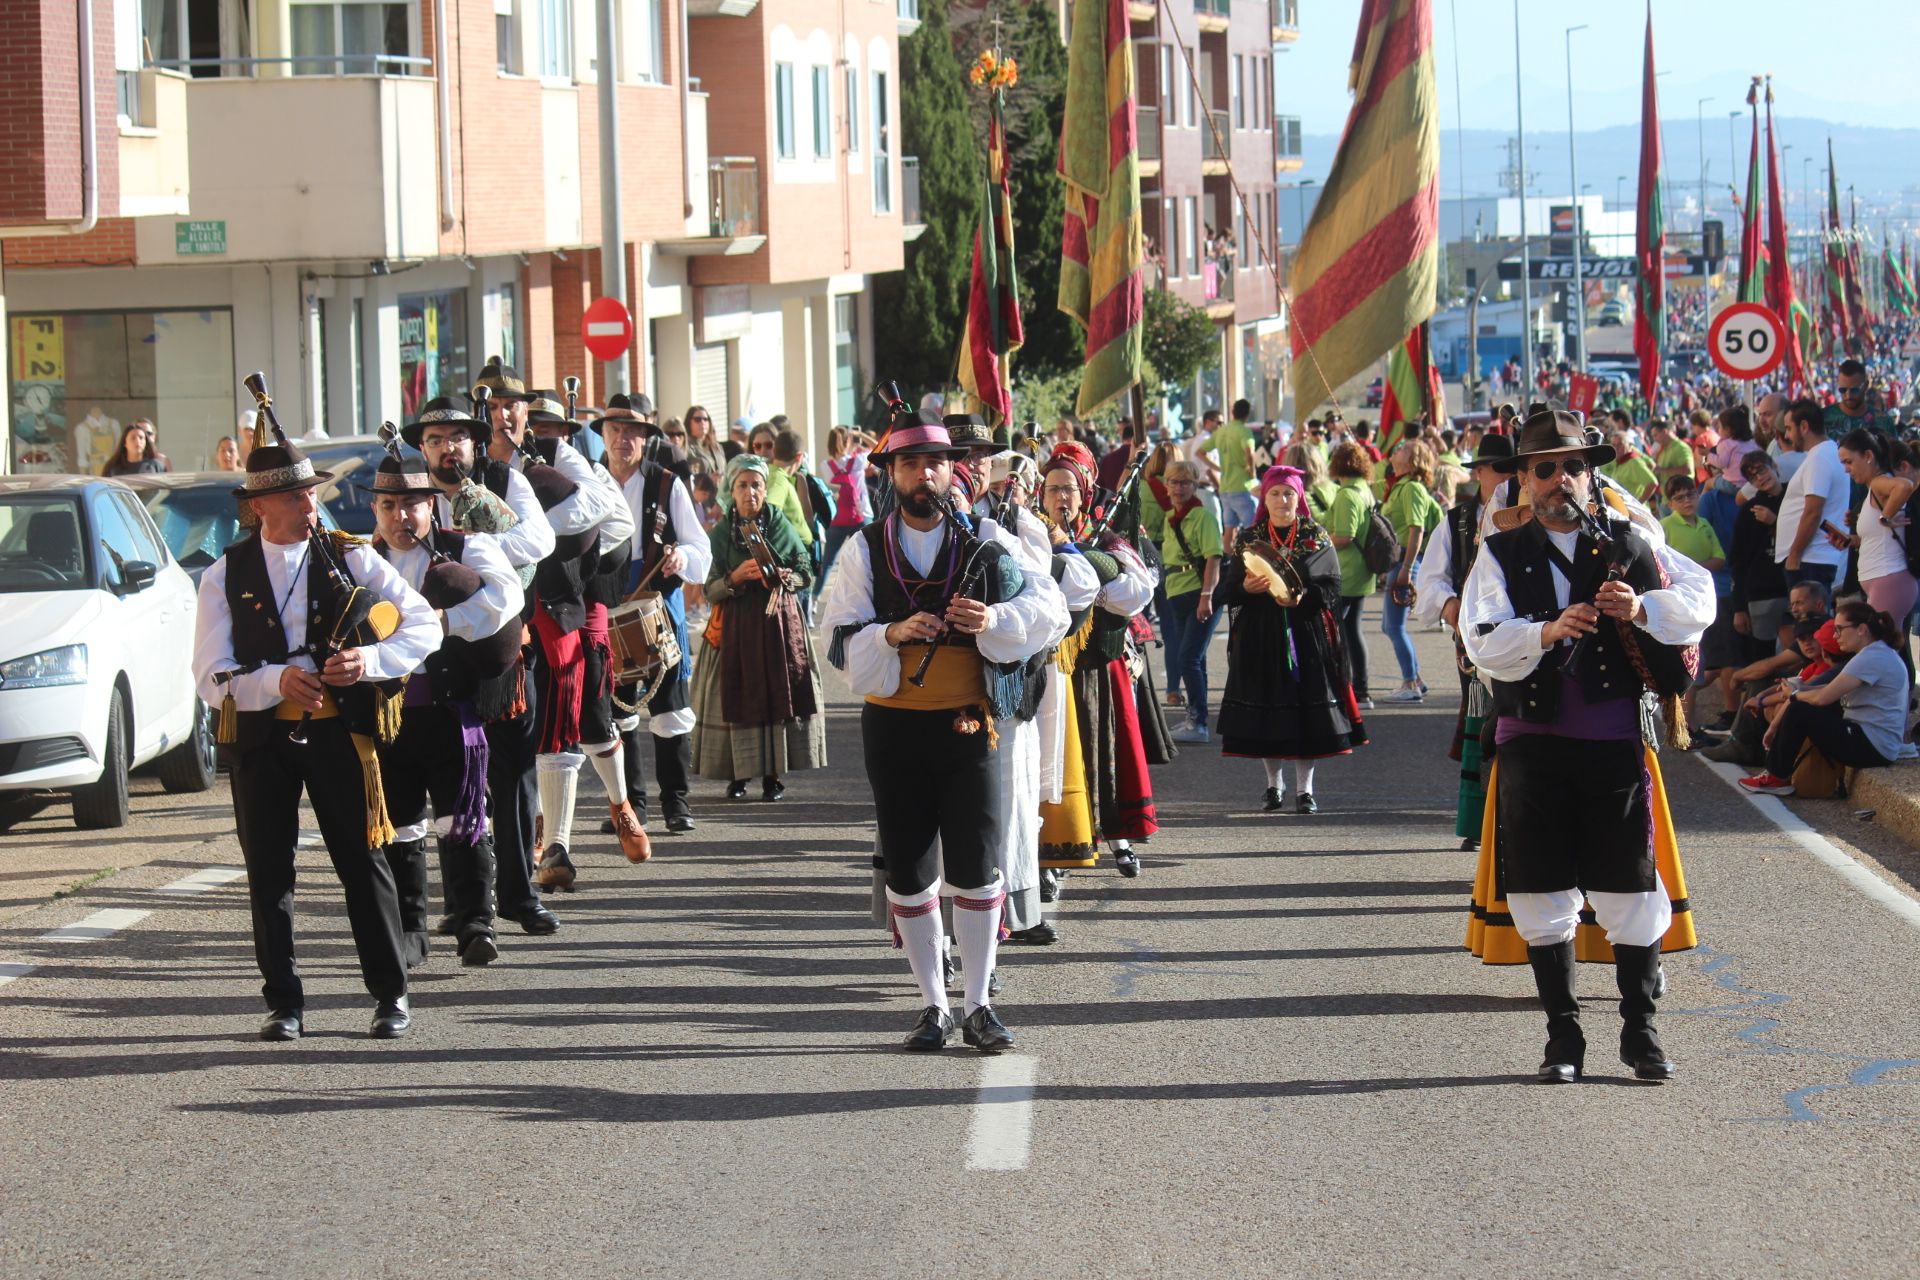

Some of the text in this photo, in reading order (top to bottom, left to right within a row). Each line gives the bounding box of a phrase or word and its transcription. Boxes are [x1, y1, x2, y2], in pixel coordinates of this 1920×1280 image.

[190, 223, 218, 231] CALLE
[189, 231, 222, 242] ALCALDE
[1540, 260, 1633, 278] REPSOL
[1725, 329, 1768, 354] 50
